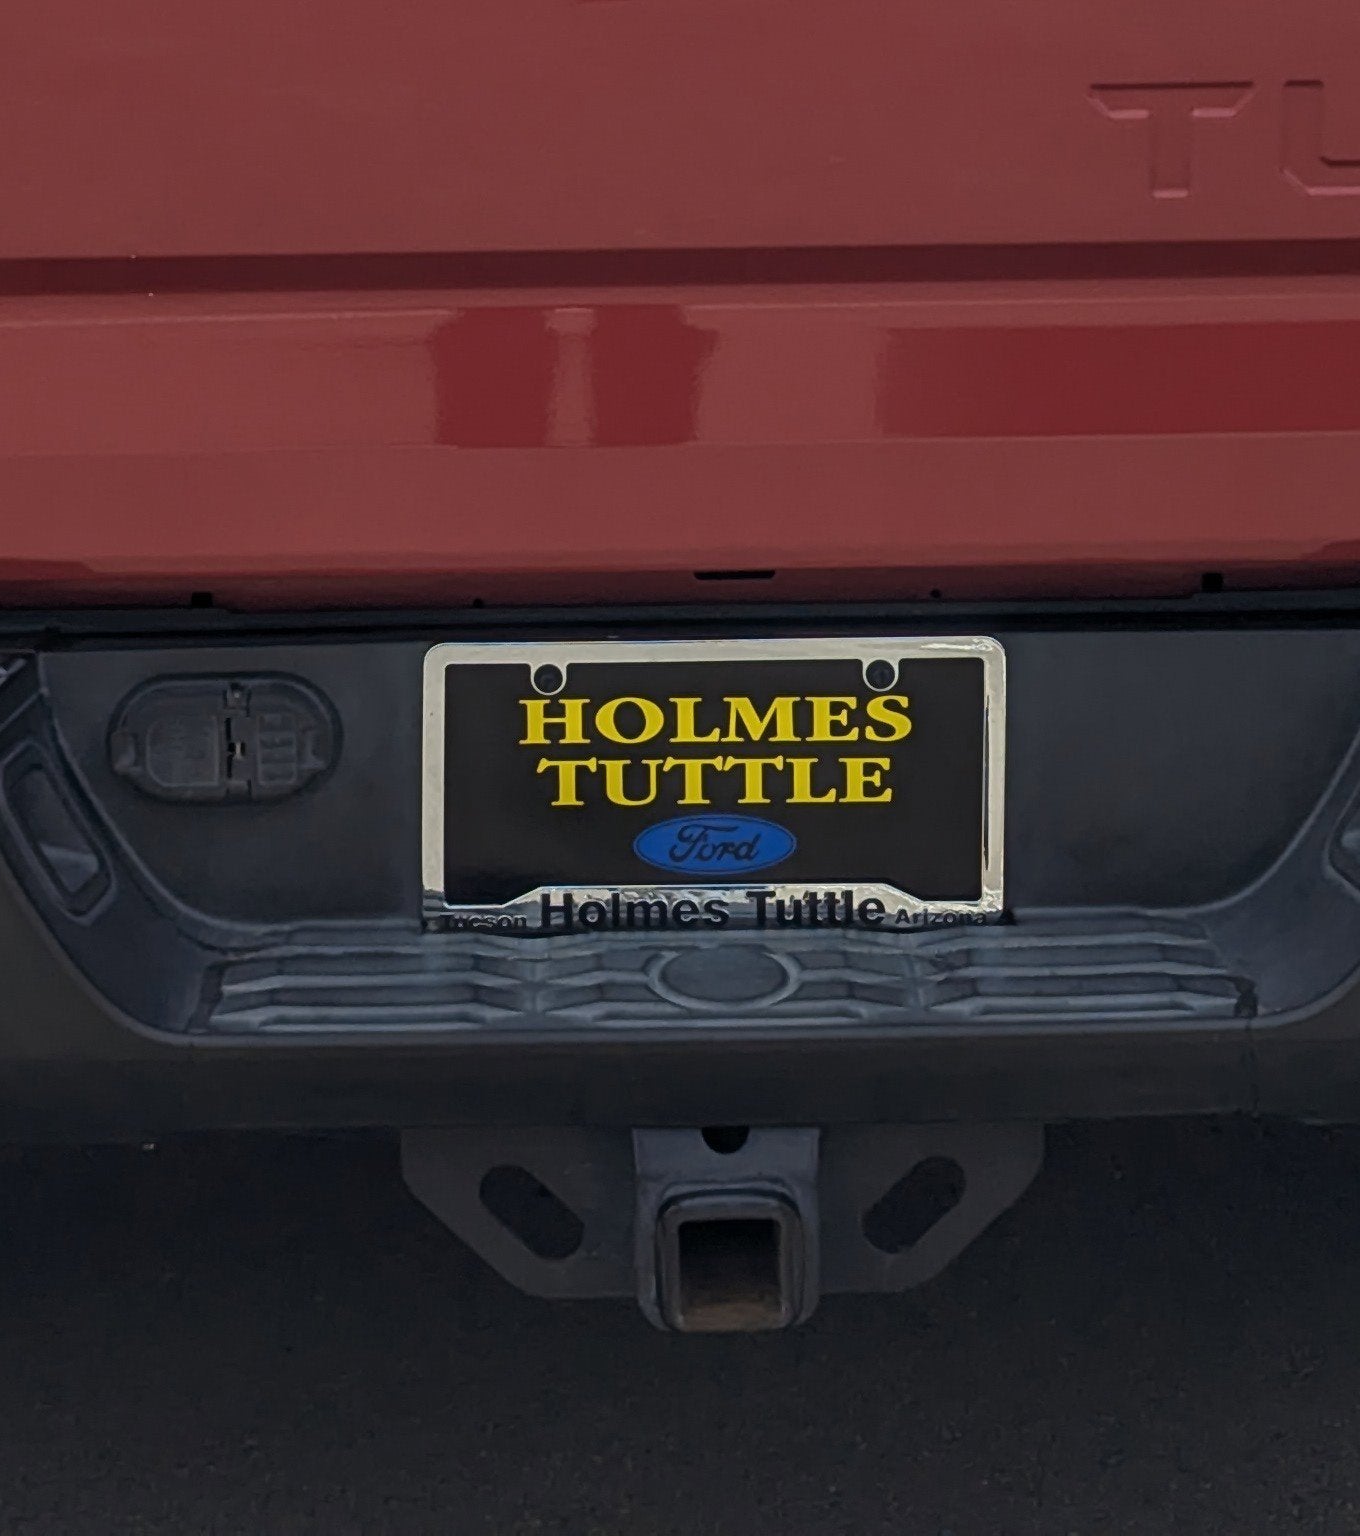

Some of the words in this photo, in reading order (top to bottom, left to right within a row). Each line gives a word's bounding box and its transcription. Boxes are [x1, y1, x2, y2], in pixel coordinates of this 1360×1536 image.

[518, 694, 913, 746] HOLMES
[536, 755, 894, 806] TUTTLE
[668, 822, 762, 863] Ford
[443, 913, 529, 931] Tucson
[541, 891, 731, 929] Holmes
[745, 890, 887, 927] Tuttle
[894, 907, 989, 927] Arizona
